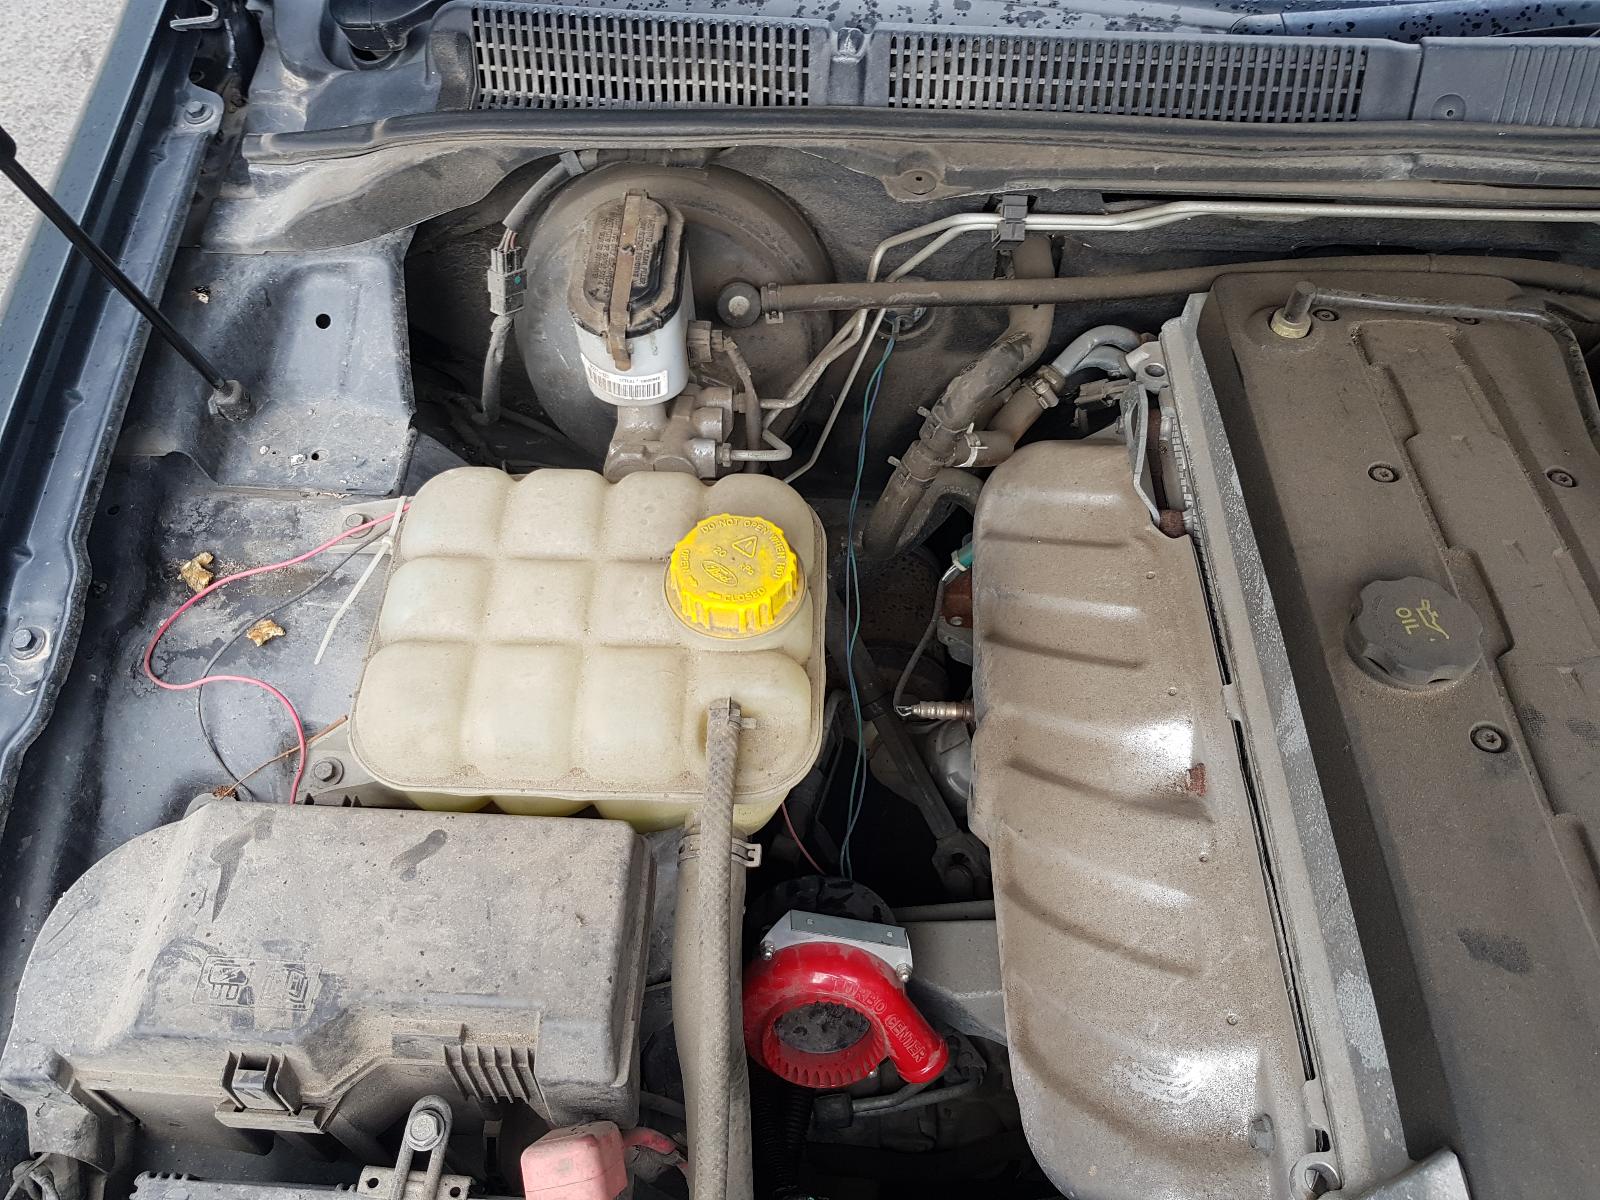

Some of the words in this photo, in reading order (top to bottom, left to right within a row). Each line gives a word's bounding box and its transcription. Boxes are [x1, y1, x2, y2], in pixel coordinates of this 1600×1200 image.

[700, 523, 716, 535] DO
[719, 518, 739, 528] NOT
[744, 520, 770, 536] OPEN
[769, 534, 787, 559] WHEN
[773, 562, 787, 578] HOT
[724, 586, 767, 602] CLOSED
[1394, 606, 1420, 636] OIL
[831, 976, 887, 1013] TURBO
[884, 1012, 928, 1063] CENTER
